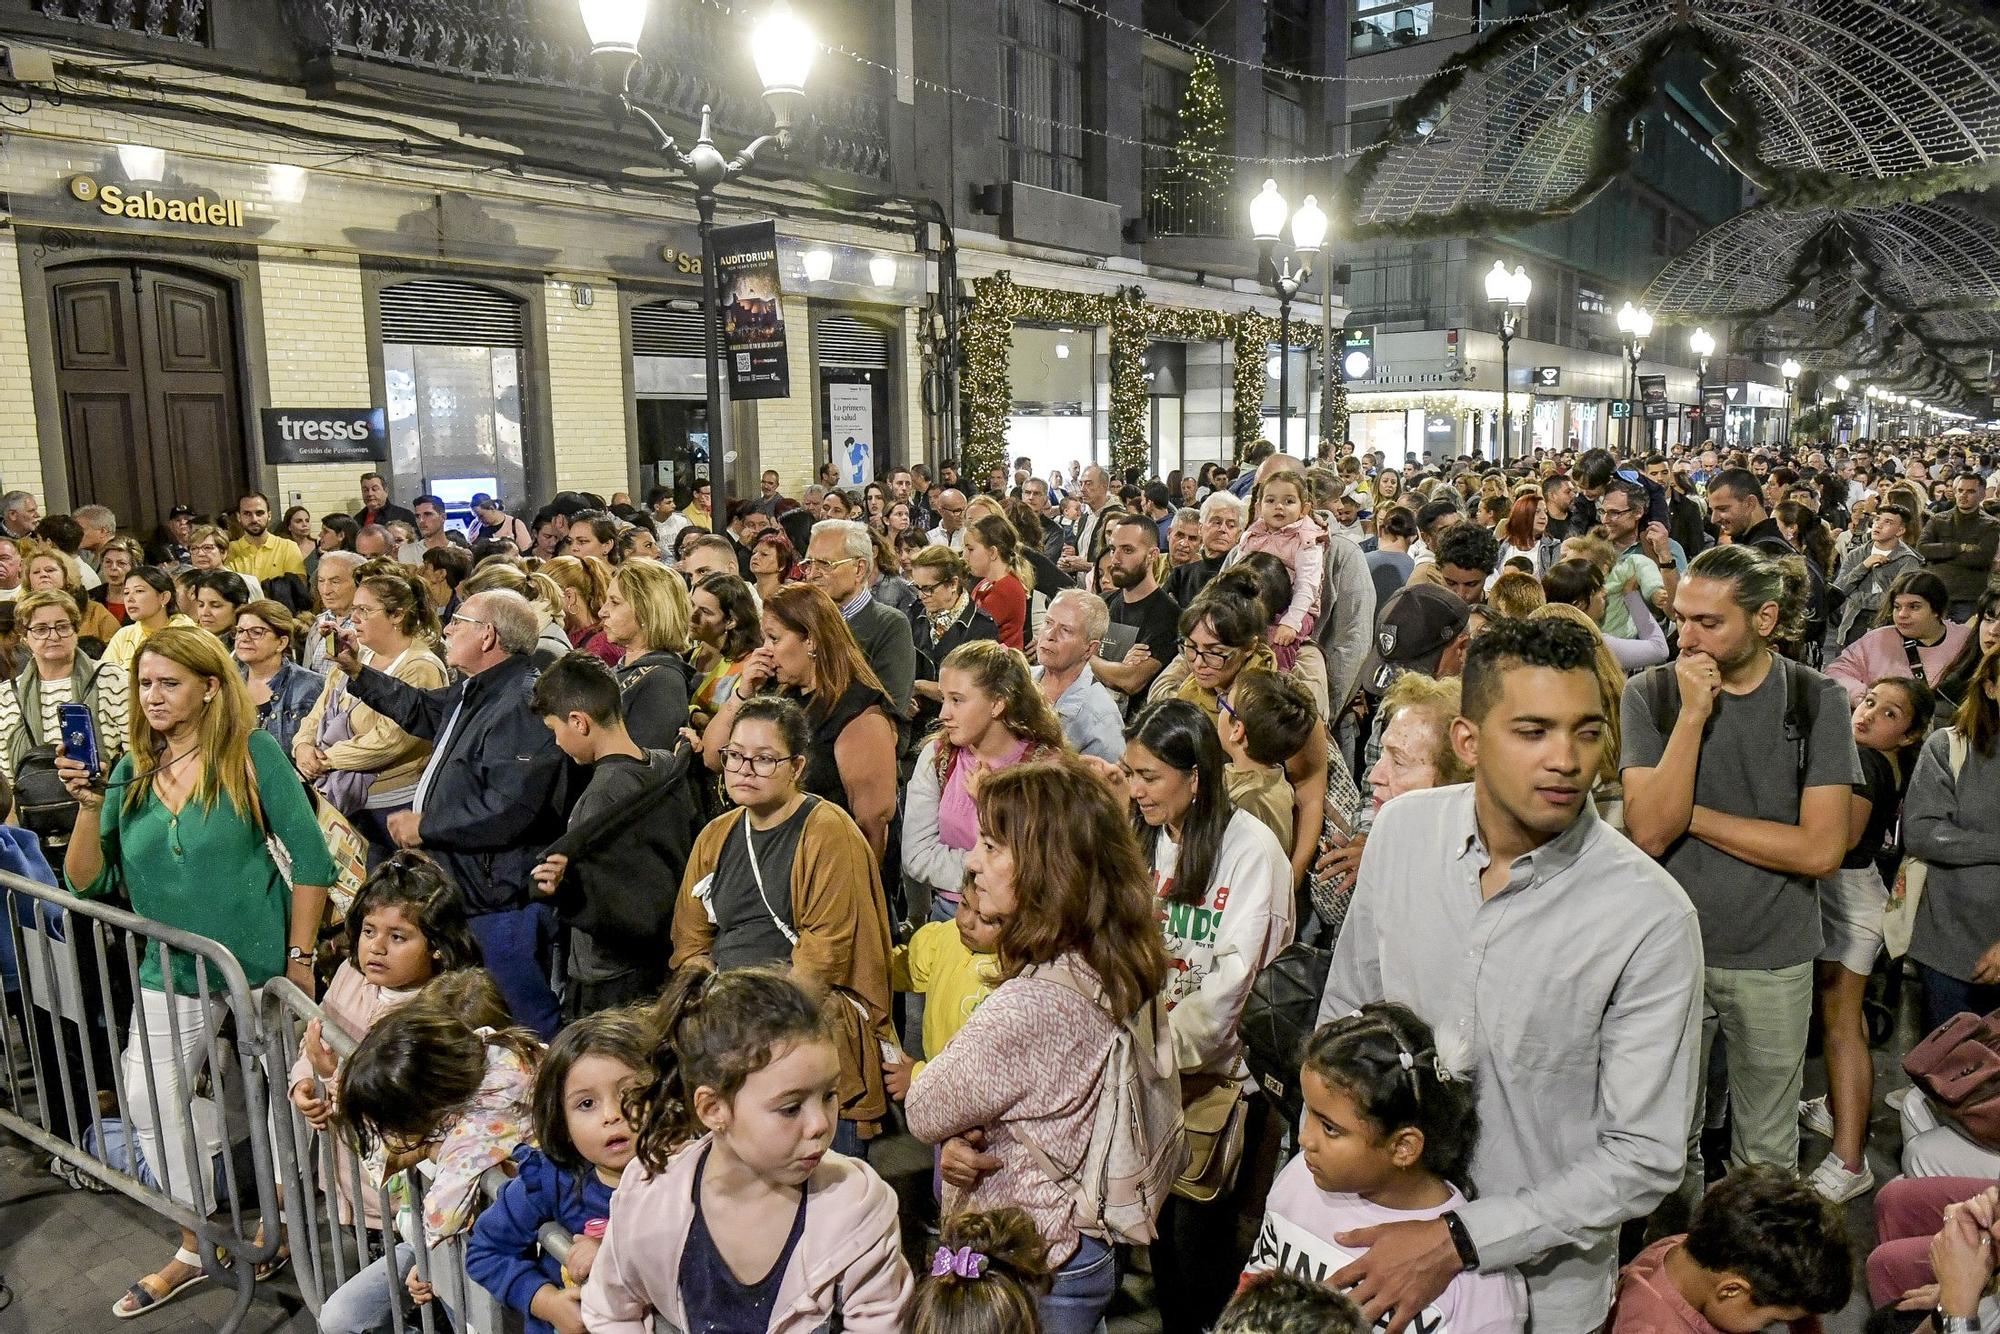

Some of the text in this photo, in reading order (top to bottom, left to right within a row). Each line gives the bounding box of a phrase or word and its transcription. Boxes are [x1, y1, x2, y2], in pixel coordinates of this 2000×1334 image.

[100, 185, 244, 227] Sabadell
[720, 250, 774, 266] AUDITORIUM
[1346, 339, 1370, 347] ROLEX
[277, 415, 369, 441] tressis
[299, 447, 323, 455] Gestión
[323, 447, 332, 455] de
